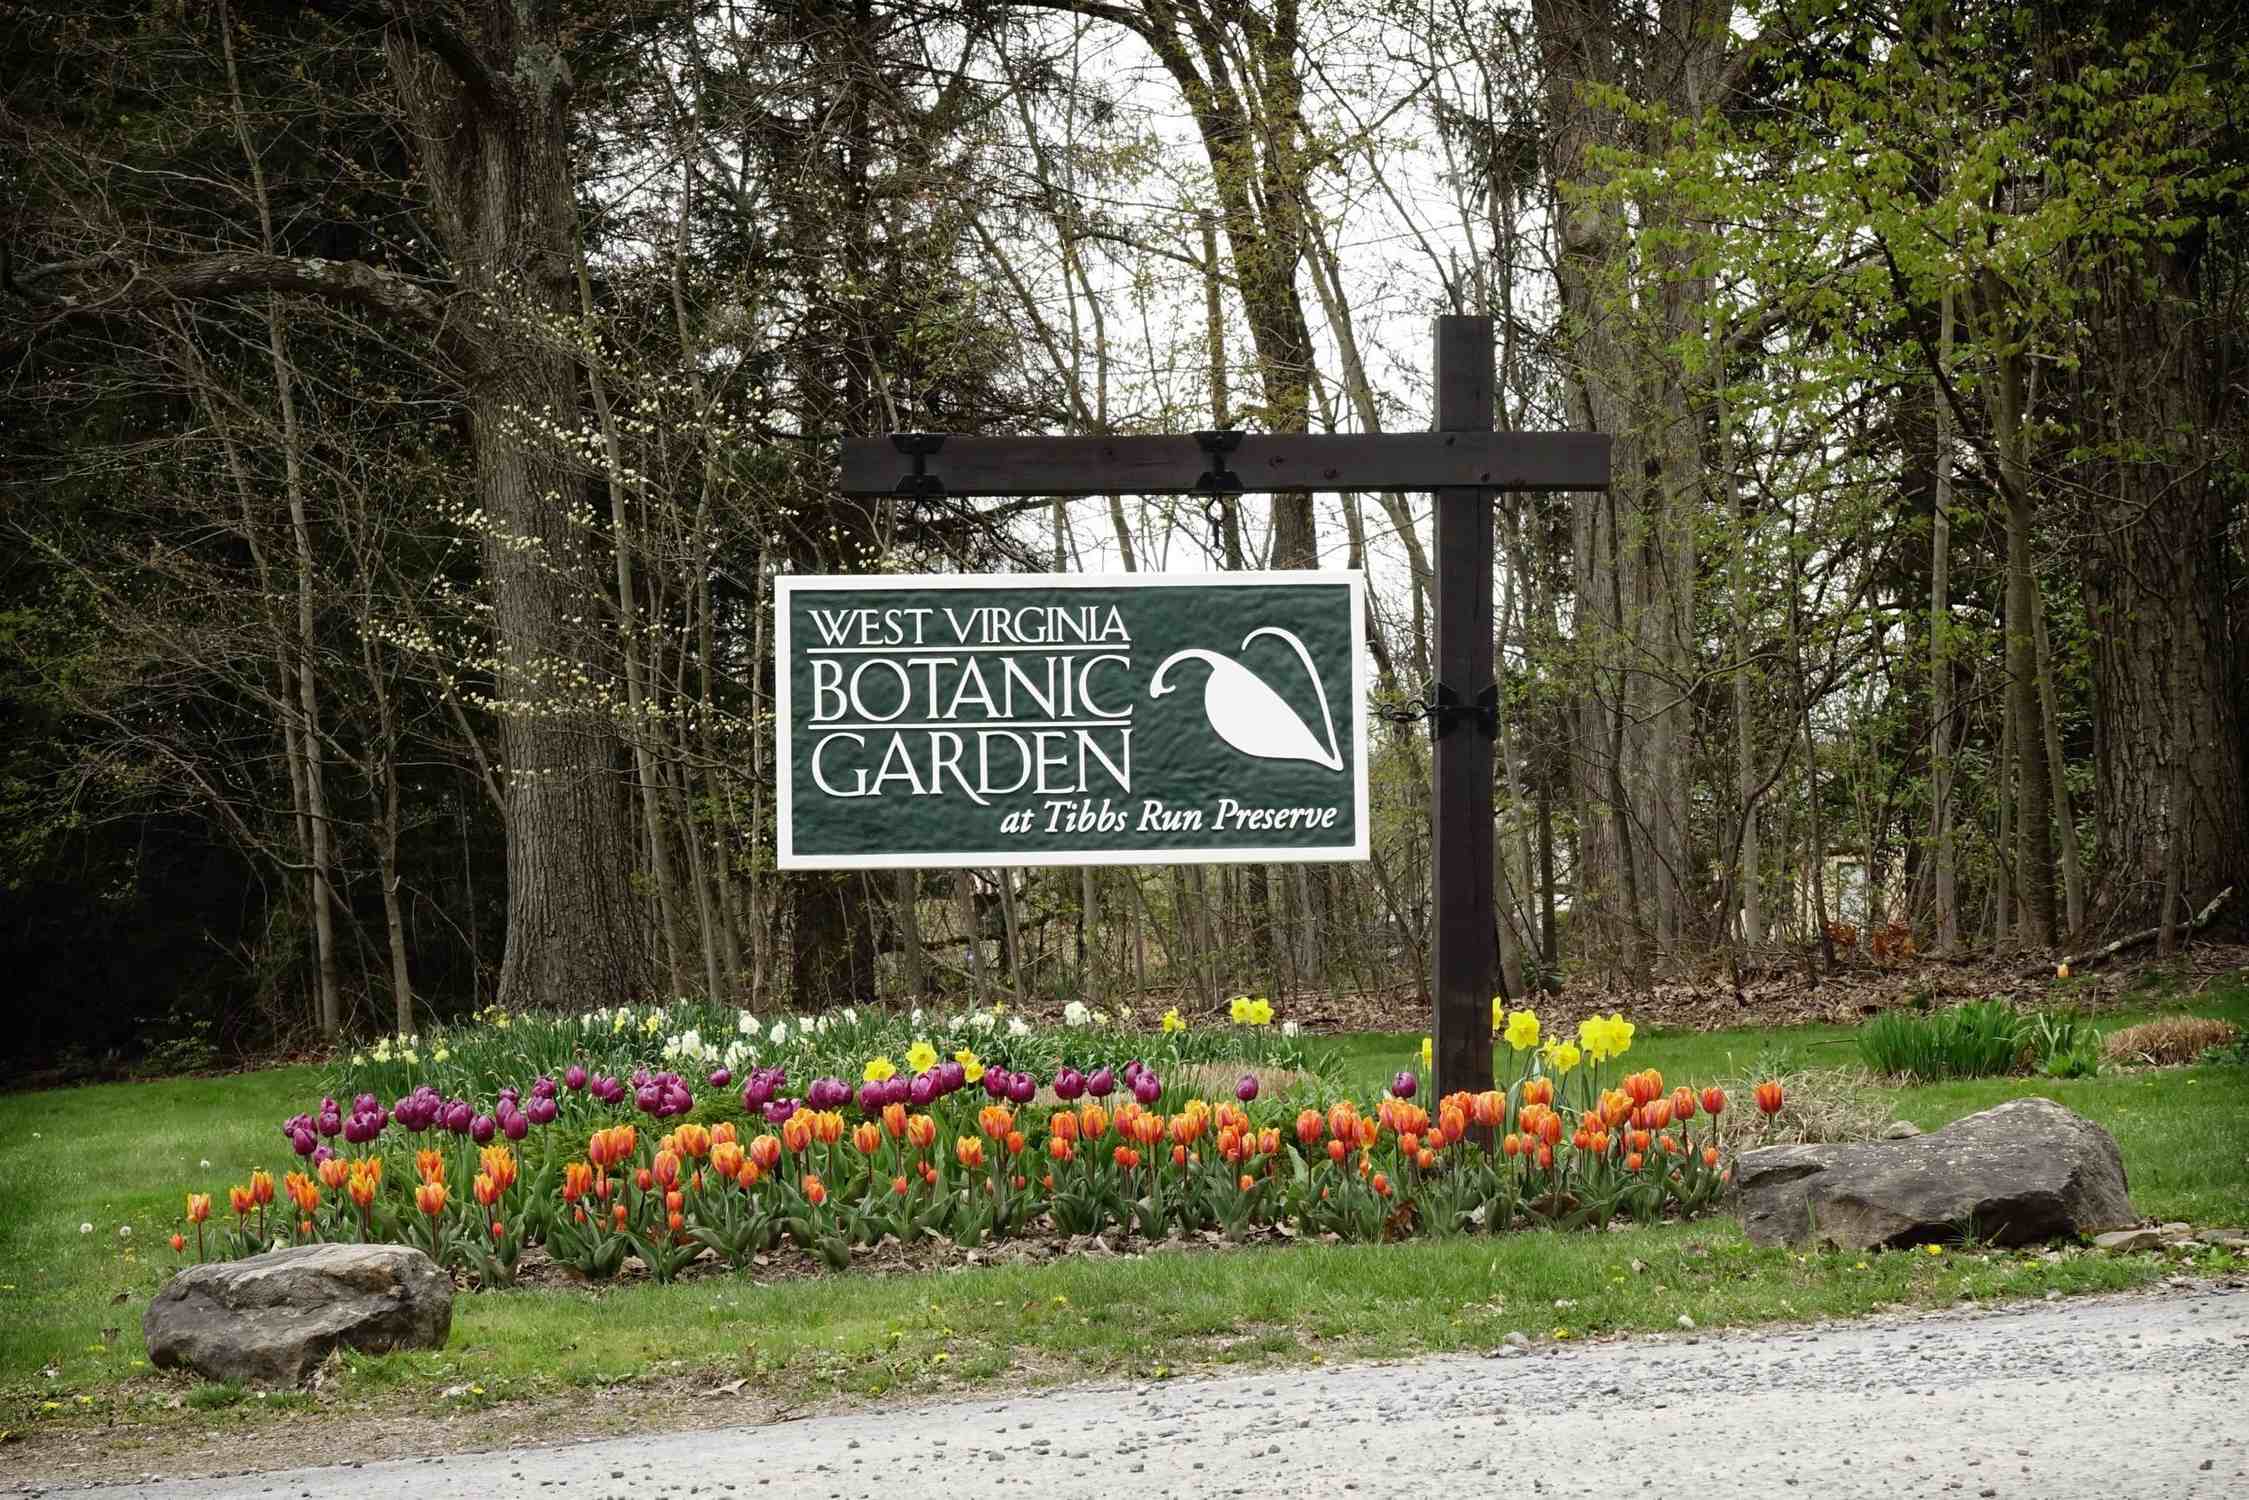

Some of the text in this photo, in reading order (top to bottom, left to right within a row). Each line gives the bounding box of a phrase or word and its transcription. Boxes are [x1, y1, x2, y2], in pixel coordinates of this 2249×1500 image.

[808, 604, 1131, 646] WEST VIRGINIA
[810, 654, 1134, 722] BOTANIC
[811, 728, 1132, 806] GARDEN
[1000, 798, 1338, 834] at Tibbs Run Preserve
